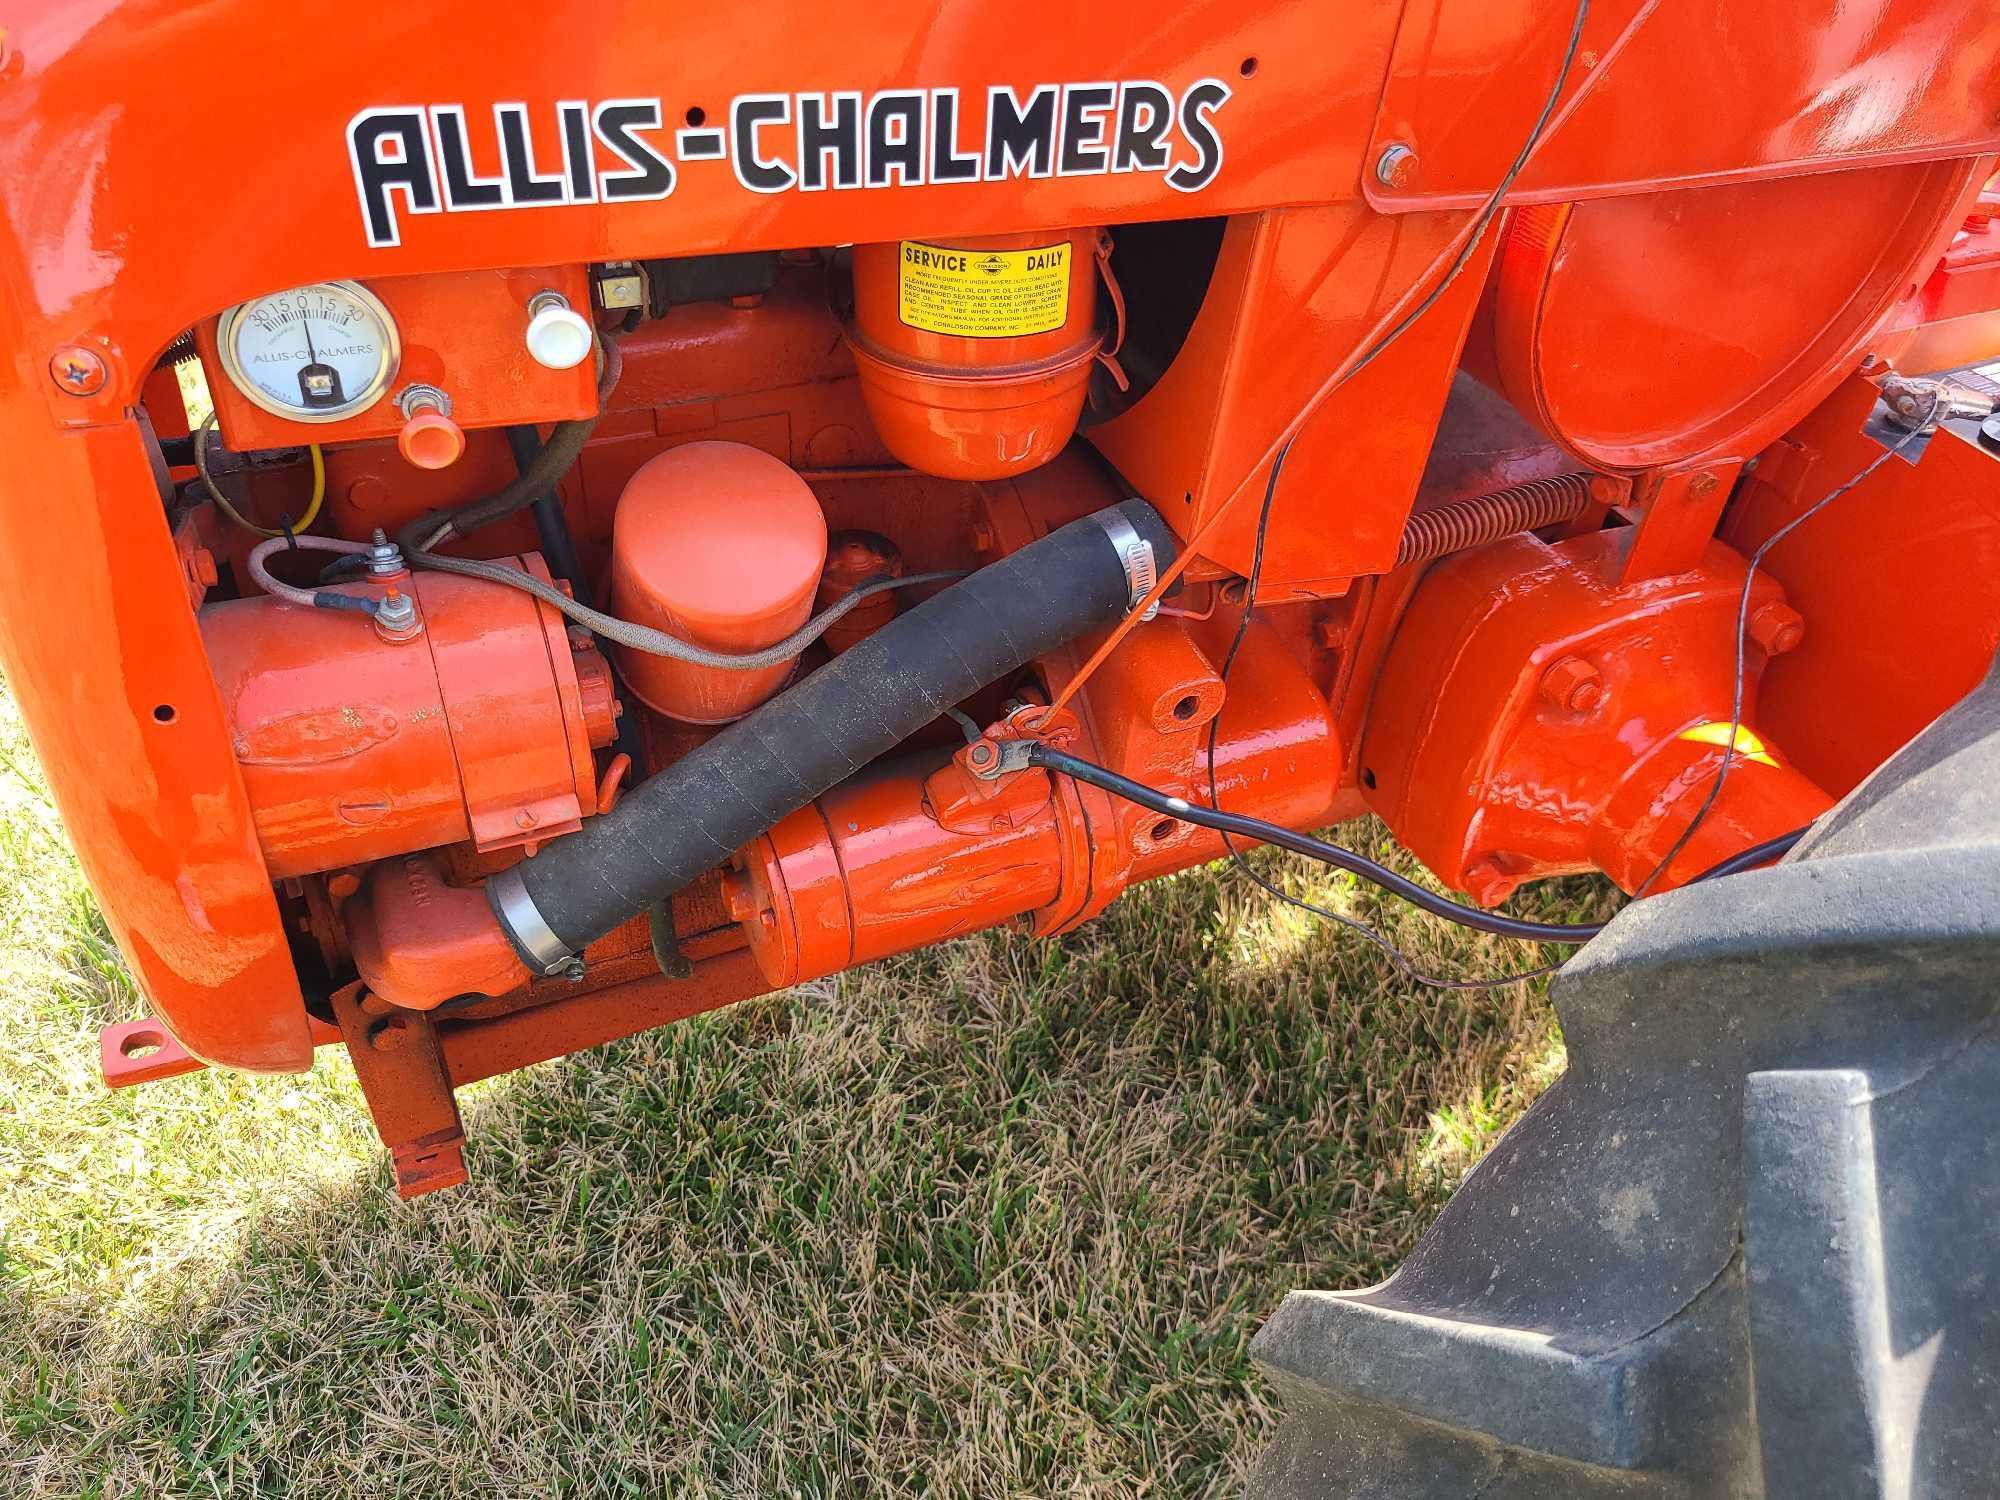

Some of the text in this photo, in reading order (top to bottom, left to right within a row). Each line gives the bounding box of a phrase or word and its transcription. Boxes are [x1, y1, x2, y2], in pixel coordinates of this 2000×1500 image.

[346, 77, 1232, 248] ALLIS-CHALMERS
[905, 247, 967, 272] SERVICE
[1027, 250, 1063, 271] DAILY
[904, 276, 925, 286] CLEAN
[904, 283, 952, 298] RECOMMENDED
[953, 293, 987, 301] SEASONAL
[1024, 291, 1045, 299] ENGINE
[904, 290, 920, 298] CASE
[940, 299, 968, 307] INSPECT
[1015, 299, 1037, 307] LOWER
[1040, 294, 1062, 303] SCREEN
[248, 295, 365, 327] 30 15 0 15 30
[904, 296, 917, 305] AND
[921, 302, 945, 311] CENTER
[1030, 302, 1058, 311] SERVICED
[934, 320, 974, 330] DONALDSON
